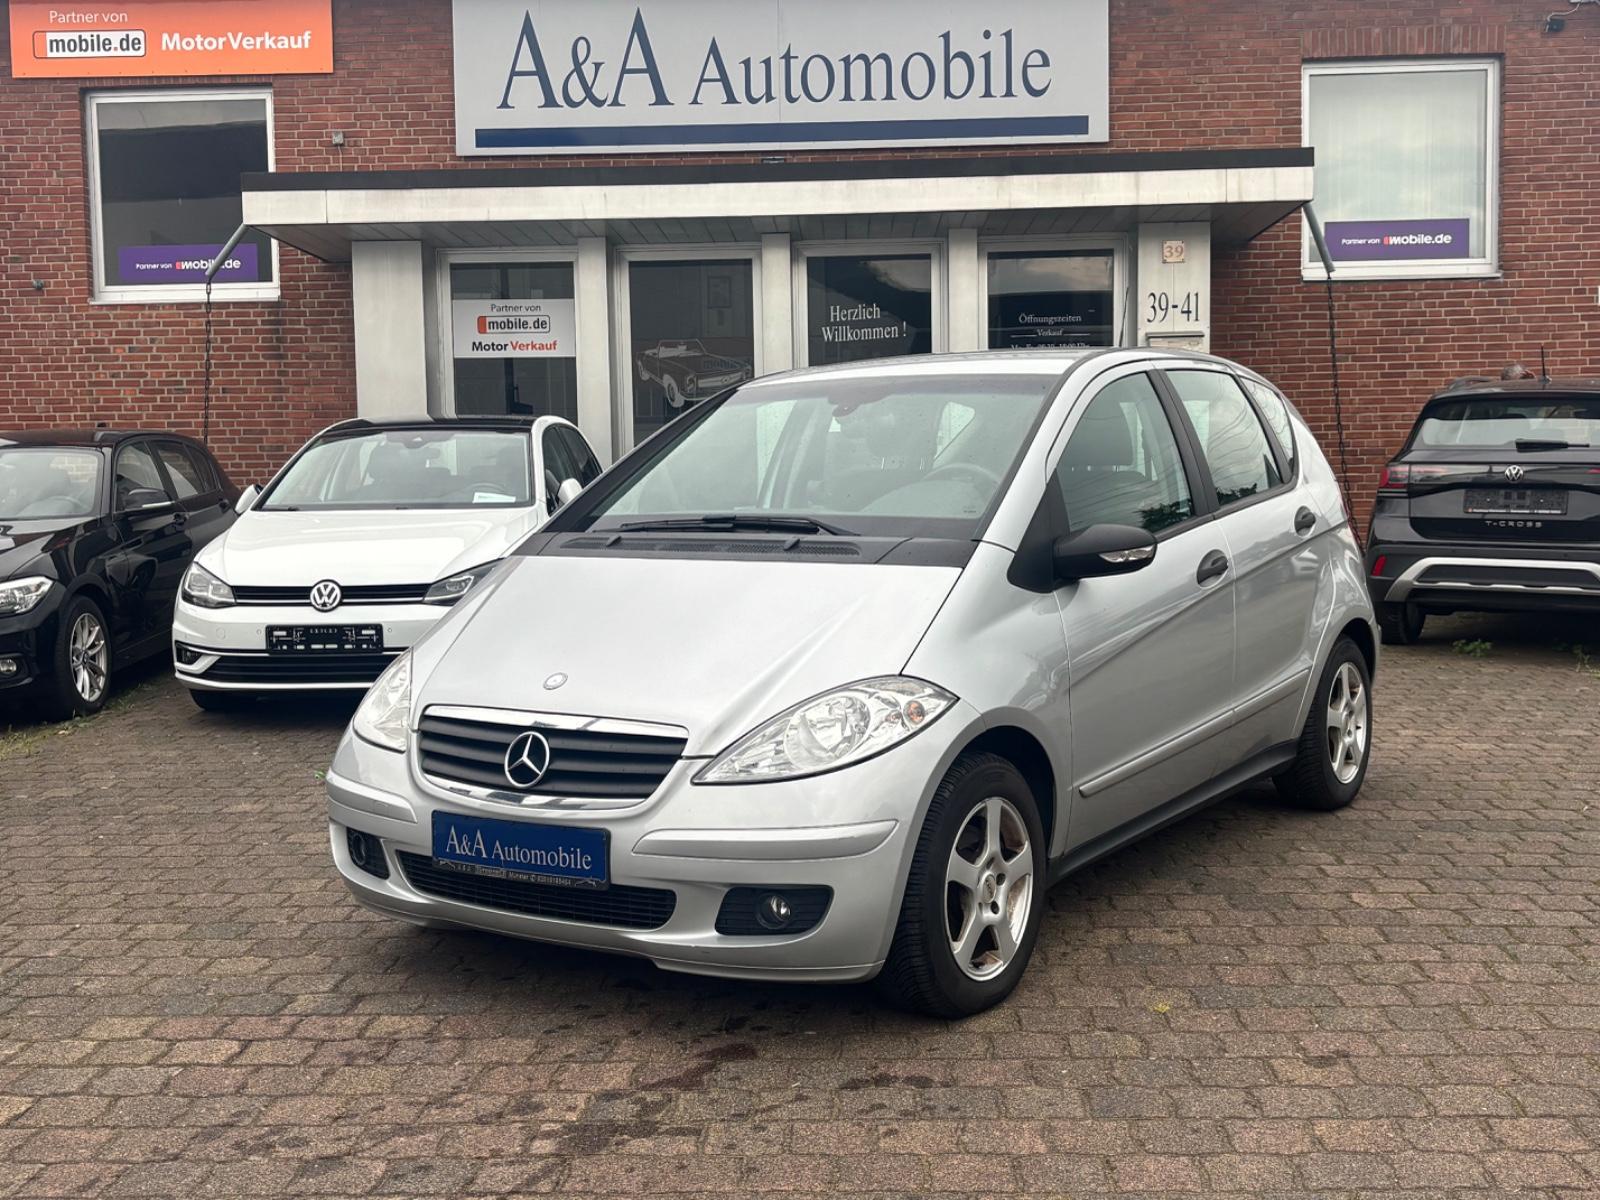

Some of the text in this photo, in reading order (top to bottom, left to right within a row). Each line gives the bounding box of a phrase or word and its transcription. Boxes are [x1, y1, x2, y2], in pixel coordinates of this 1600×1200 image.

[49, 10, 128, 24] Partner von
[49, 33, 142, 53] mobile.de
[496, 6, 1052, 110] A&A Automobile
[1341, 238, 1367, 246] Partner
[1388, 233, 1453, 246] mobile.de
[1165, 245, 1184, 258] 39
[135, 262, 160, 270] Partner
[490, 303, 542, 313] Partner von
[830, 303, 881, 322] Herzlich
[488, 317, 548, 330] mobile.de
[1018, 313, 1082, 325] Öffnungszeiten
[821, 325, 899, 342] Willkommen
[1036, 328, 1065, 337] Verkauf
[471, 340, 558, 352] Motor Verkauf
[446, 825, 592, 870] A&A Automobile
